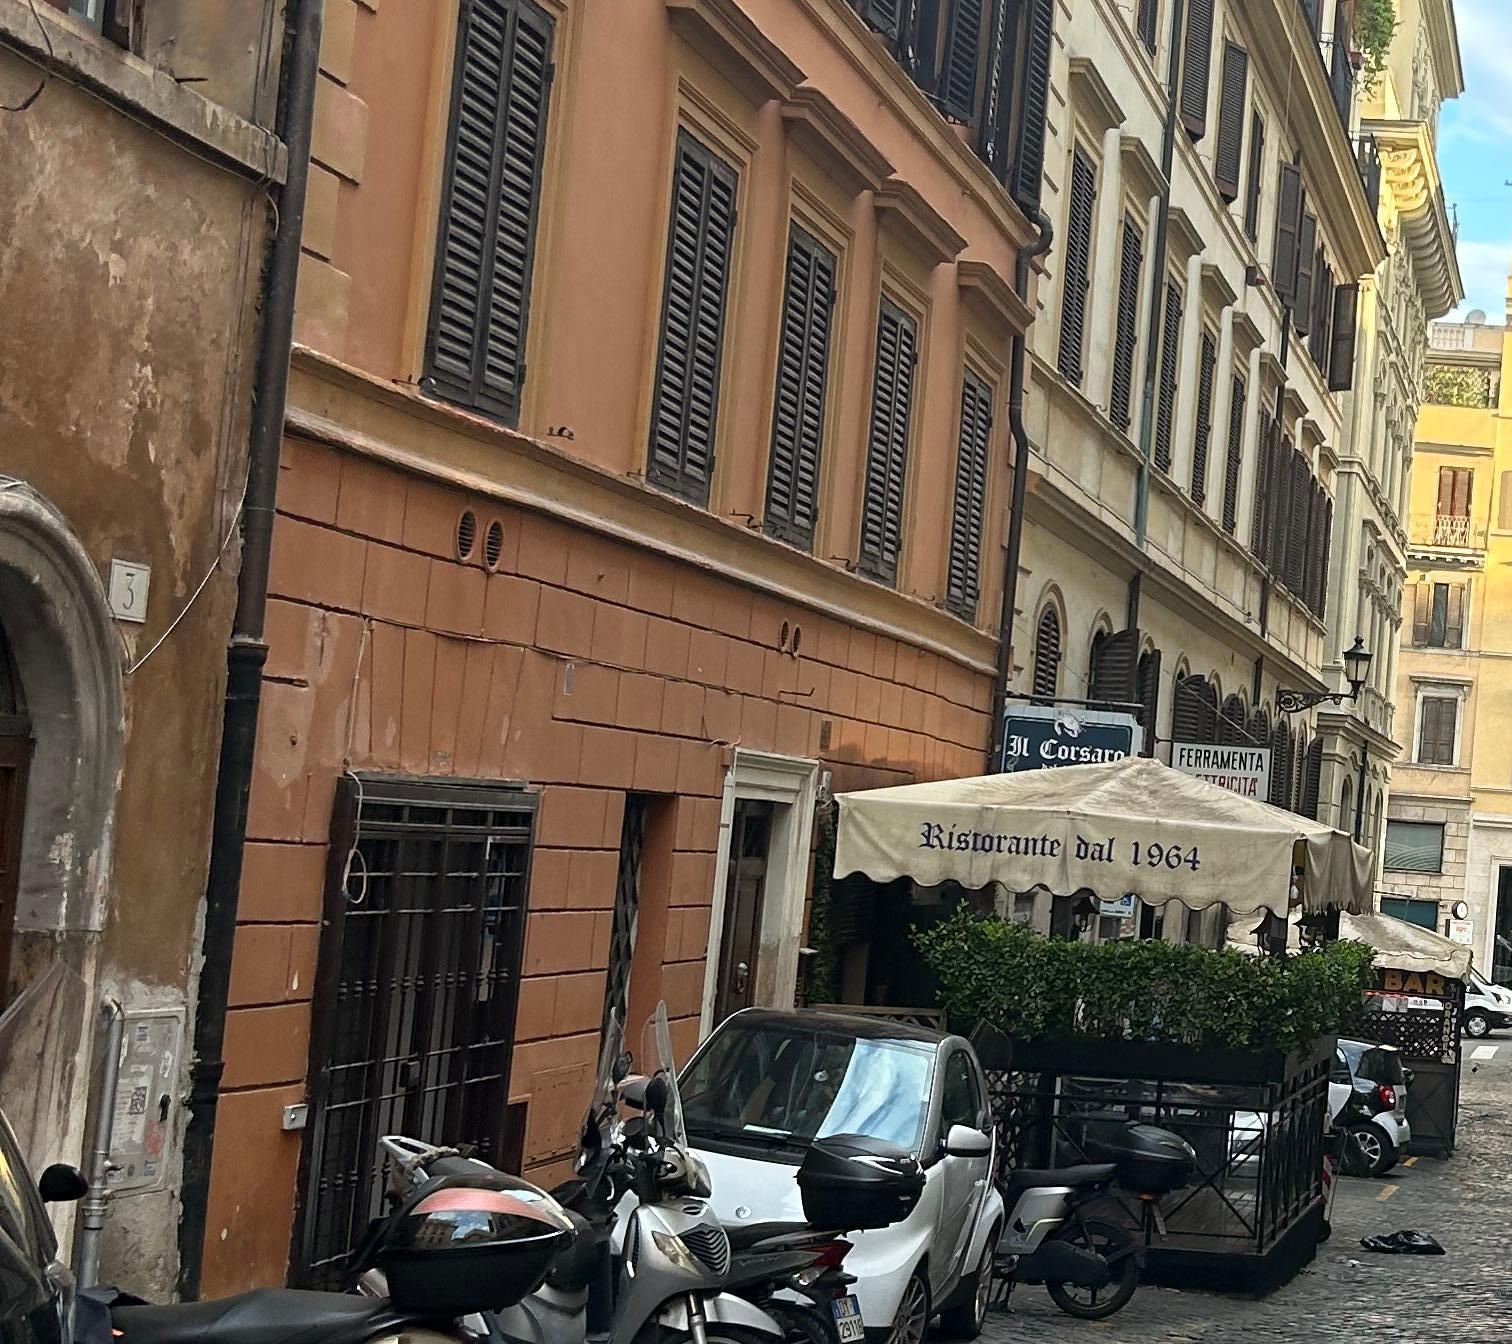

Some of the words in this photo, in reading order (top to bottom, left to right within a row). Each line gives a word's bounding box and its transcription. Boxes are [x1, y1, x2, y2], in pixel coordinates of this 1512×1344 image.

[122, 572, 136, 610] 3
[1006, 734, 1030, 757] Il
[1039, 738, 1126, 763] Corsaro
[1179, 747, 1264, 772] FERRAMENTA
[919, 822, 1061, 857] Ristorante
[1074, 834, 1115, 863] dal
[1131, 840, 1201, 871] 1964
[1384, 970, 1446, 995] BAR
